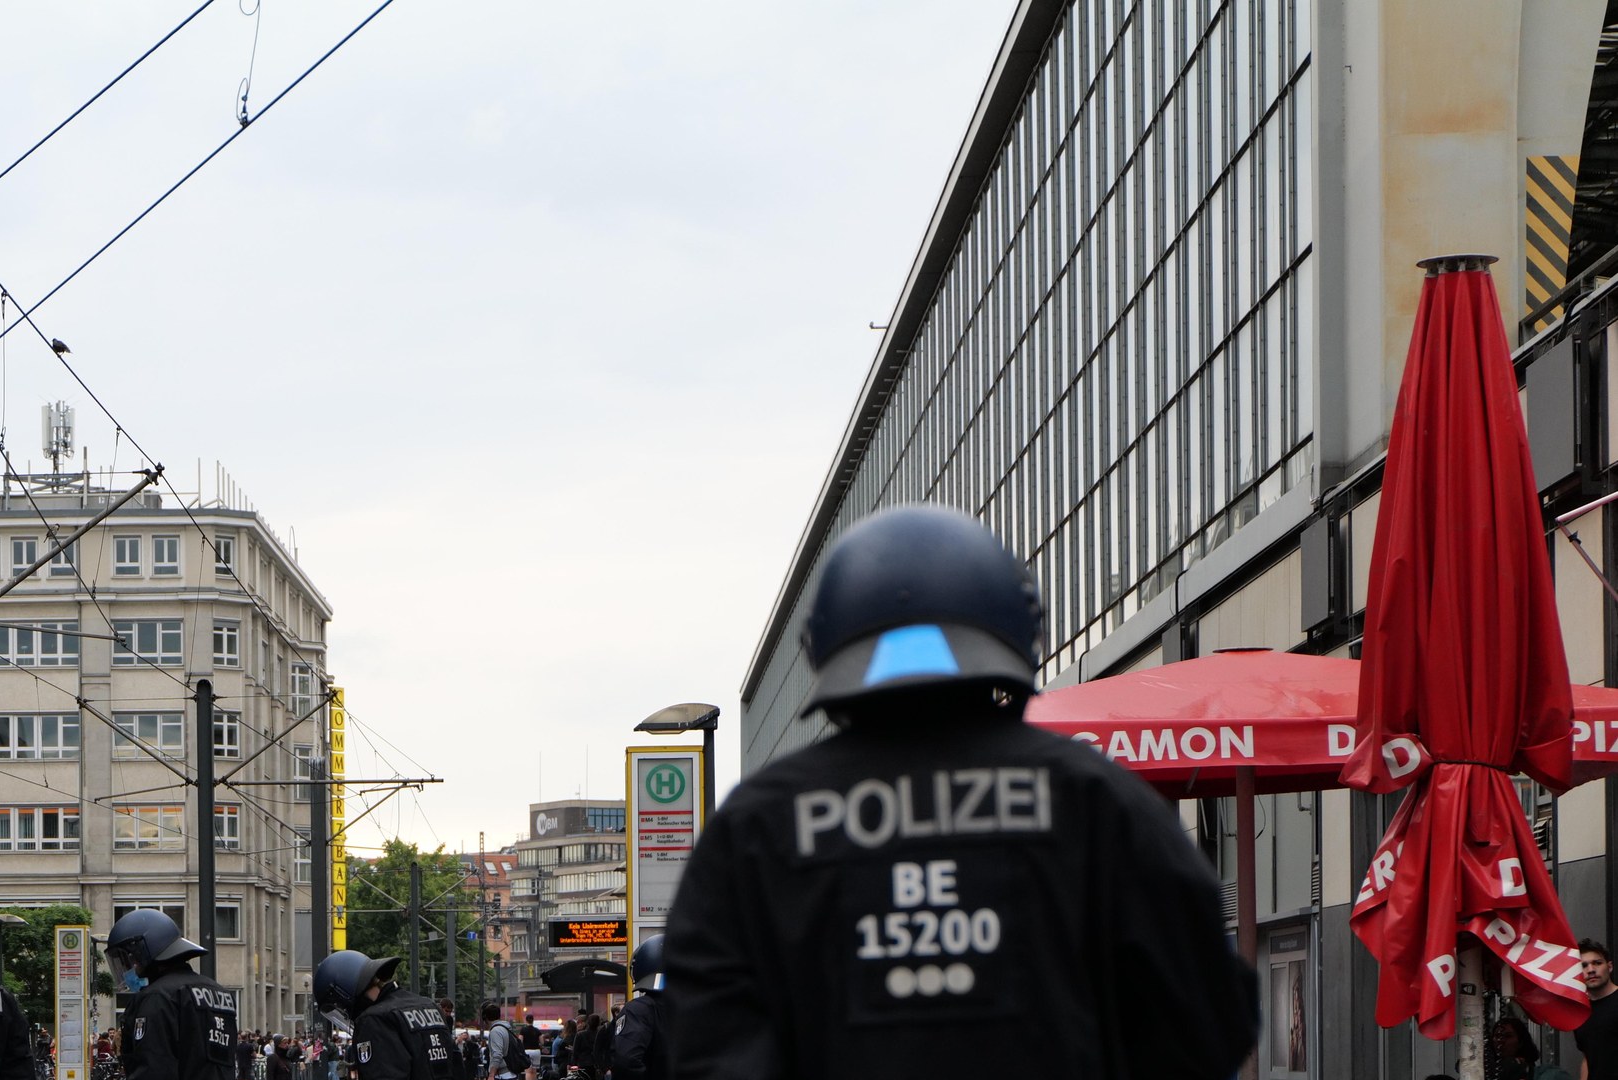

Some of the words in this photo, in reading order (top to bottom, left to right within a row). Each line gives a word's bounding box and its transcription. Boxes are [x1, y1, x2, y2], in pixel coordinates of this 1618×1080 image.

[332, 689, 344, 926] COMMERZBANK
[793, 767, 1052, 857] POLIZEI
[538, 815, 558, 832] WBM
[891, 859, 959, 908] BE
[856, 907, 1001, 960] 15200
[191, 987, 236, 1011] POLIZEI
[214, 1016, 225, 1031] BE
[403, 1008, 445, 1029] POLIZEI
[429, 1034, 441, 1047] BE
